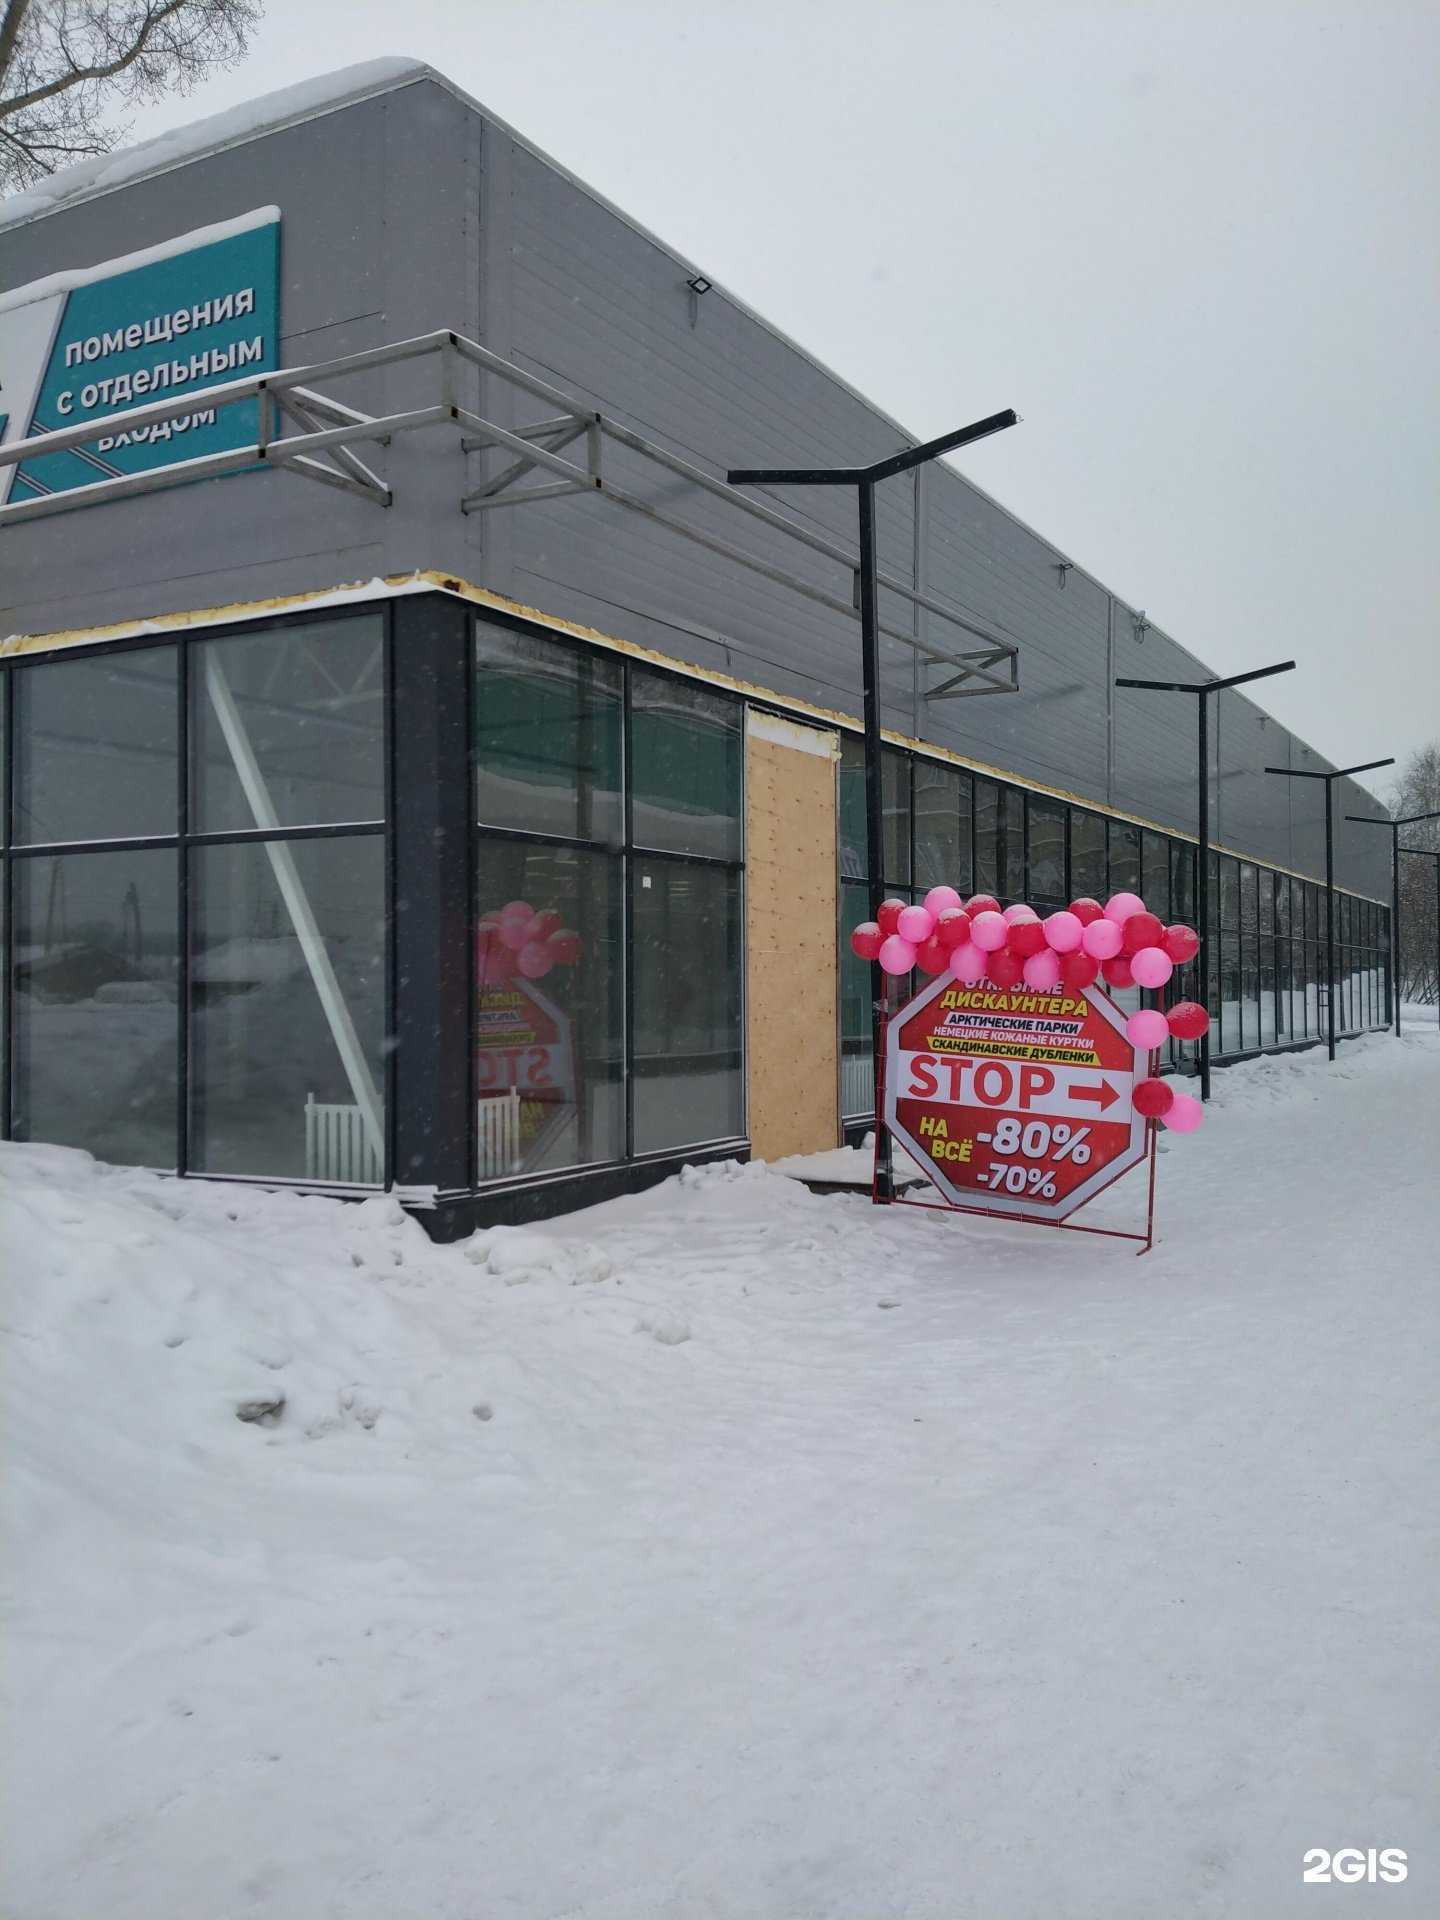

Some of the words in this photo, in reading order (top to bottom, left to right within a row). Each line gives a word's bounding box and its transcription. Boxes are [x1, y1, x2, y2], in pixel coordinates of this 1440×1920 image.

[65, 288, 255, 368] помещения
[57, 390, 73, 415] с
[80, 336, 263, 409] отдельным
[940, 990, 1088, 1017] ДИСКАУНТЕРА
[933, 1026, 989, 1041] НЕМЕЦКИЕ
[990, 1031, 1048, 1044] КОЖАНЫЕ
[1049, 1036, 1095, 1049] КУРТКИ
[949, 1014, 1034, 1031] АРКТИЧЕСКИЕ
[1035, 1021, 1079, 1034] ПАРКИ
[932, 1038, 1028, 1057] СКАНДИНАВСКИЕ
[1029, 1047, 1095, 1063] ДУБЛЕНКИ
[908, 1054, 1055, 1109] STOP
[919, 1116, 948, 1138] НА
[931, 1139, 974, 1163] ВСЁ
[976, 1117, 1092, 1165] -80%
[976, 1162, 1057, 1198] -70%
